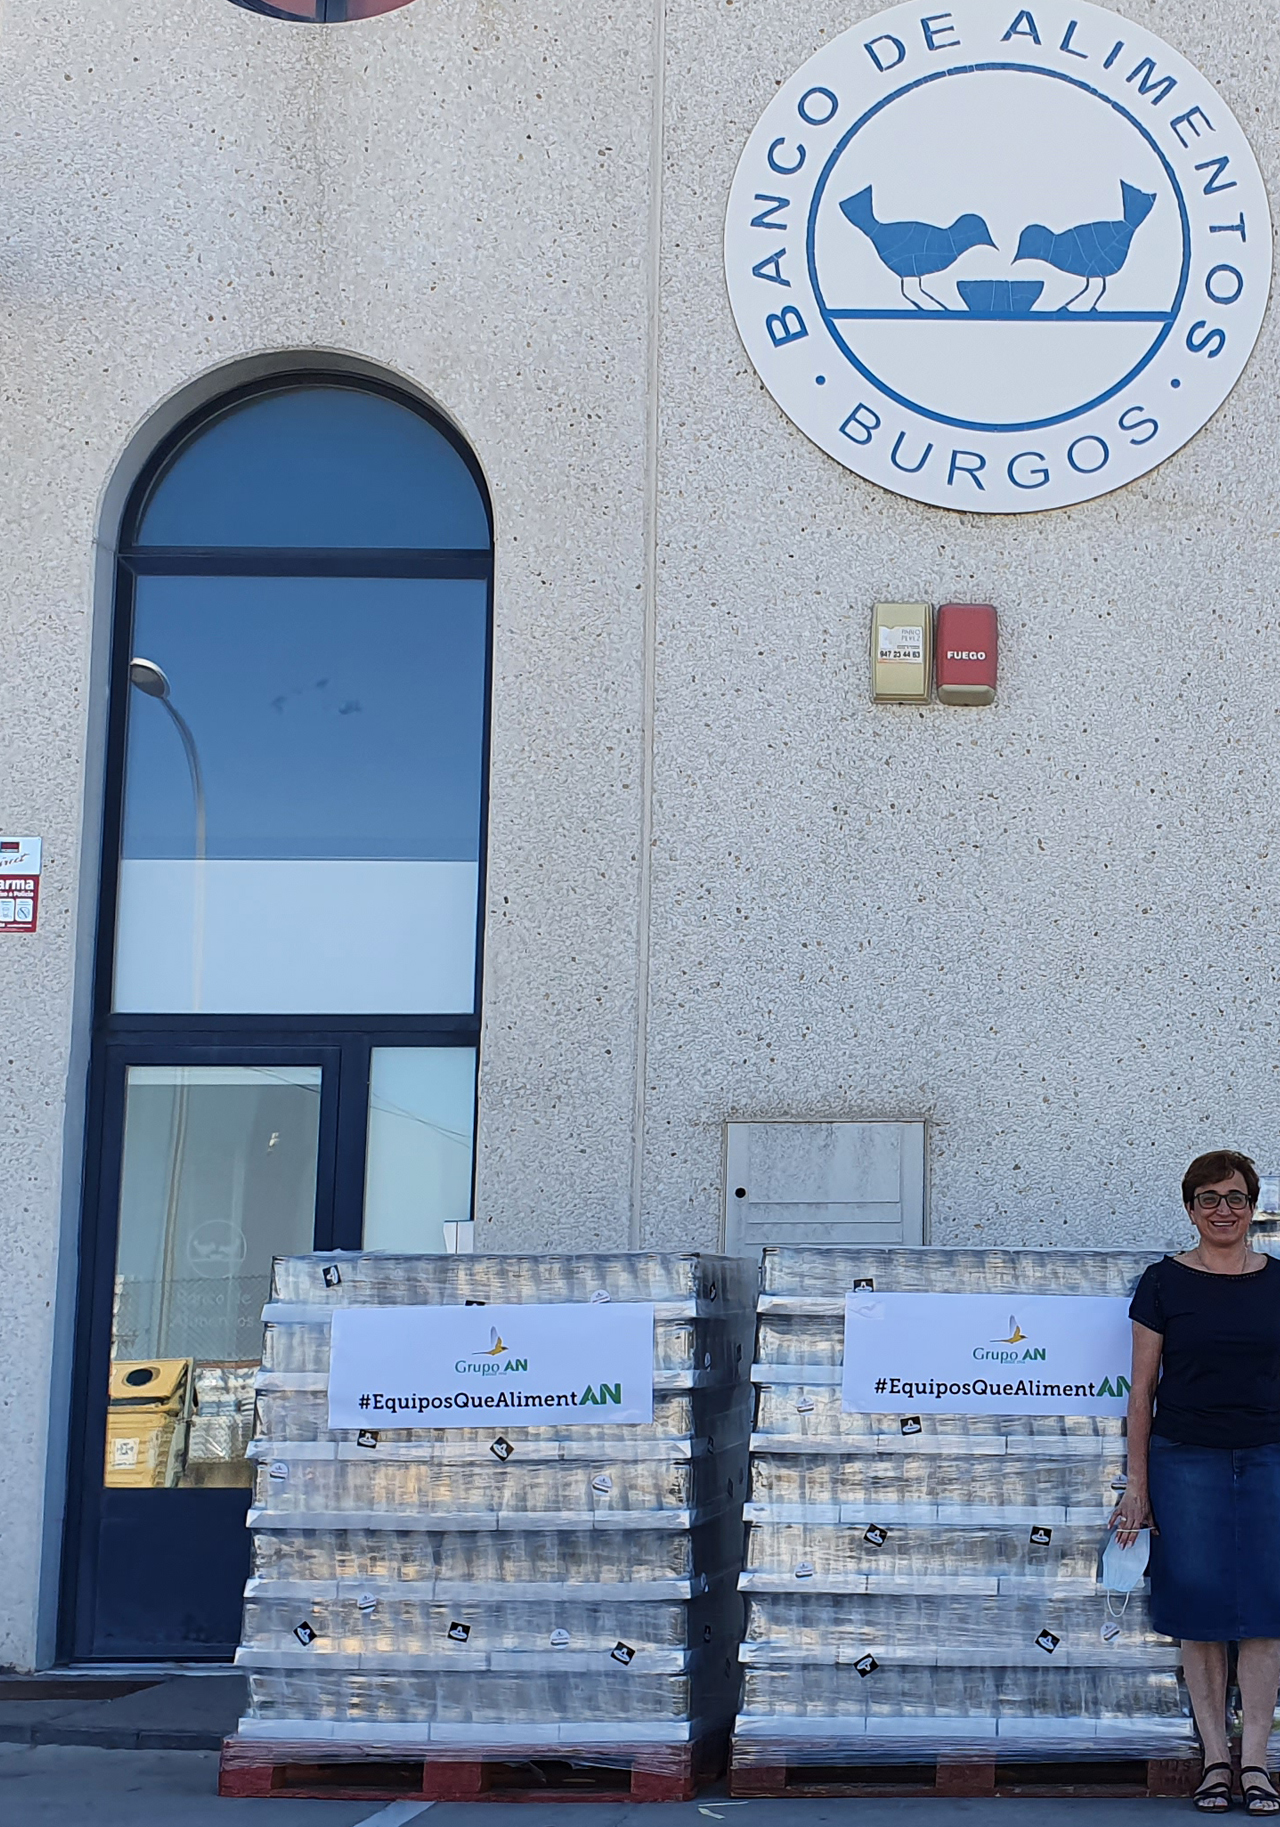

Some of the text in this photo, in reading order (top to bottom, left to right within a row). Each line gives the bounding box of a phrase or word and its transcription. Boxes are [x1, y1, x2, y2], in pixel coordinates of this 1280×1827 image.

[751, 9, 1248, 359] BANCO DE ALIMENTOS
[838, 402, 1159, 491] BURGOS
[947, 651, 986, 660] FUEGO
[455, 1358, 528, 1376] Grupo AN
[973, 1348, 1046, 1364] Grupo AN
[358, 1383, 622, 1413] #EquiposQueAlimentAN
